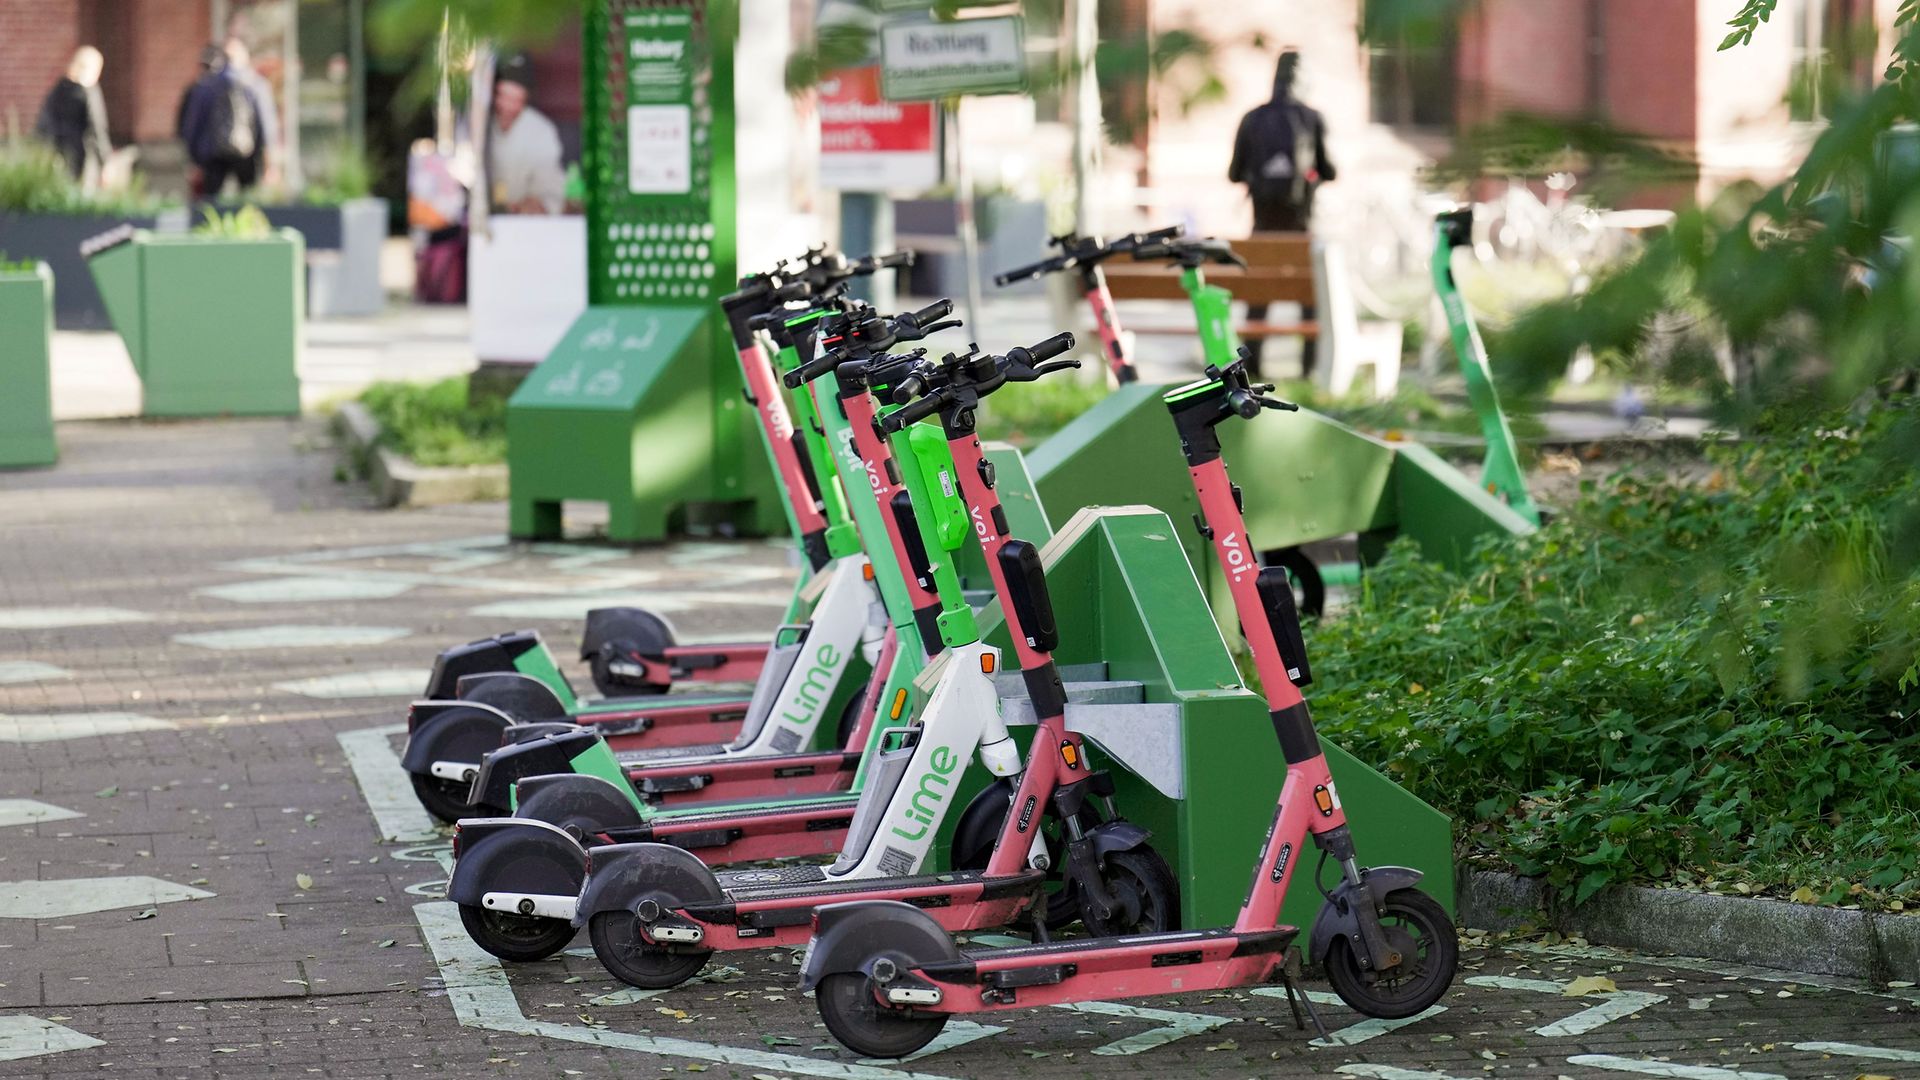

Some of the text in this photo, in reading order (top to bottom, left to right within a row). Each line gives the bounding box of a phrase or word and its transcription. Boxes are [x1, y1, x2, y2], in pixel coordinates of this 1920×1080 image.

[970, 505, 995, 551] voi.
[1222, 532, 1252, 583] voi.
[782, 643, 841, 726] Lime
[891, 745, 958, 842] Lime
